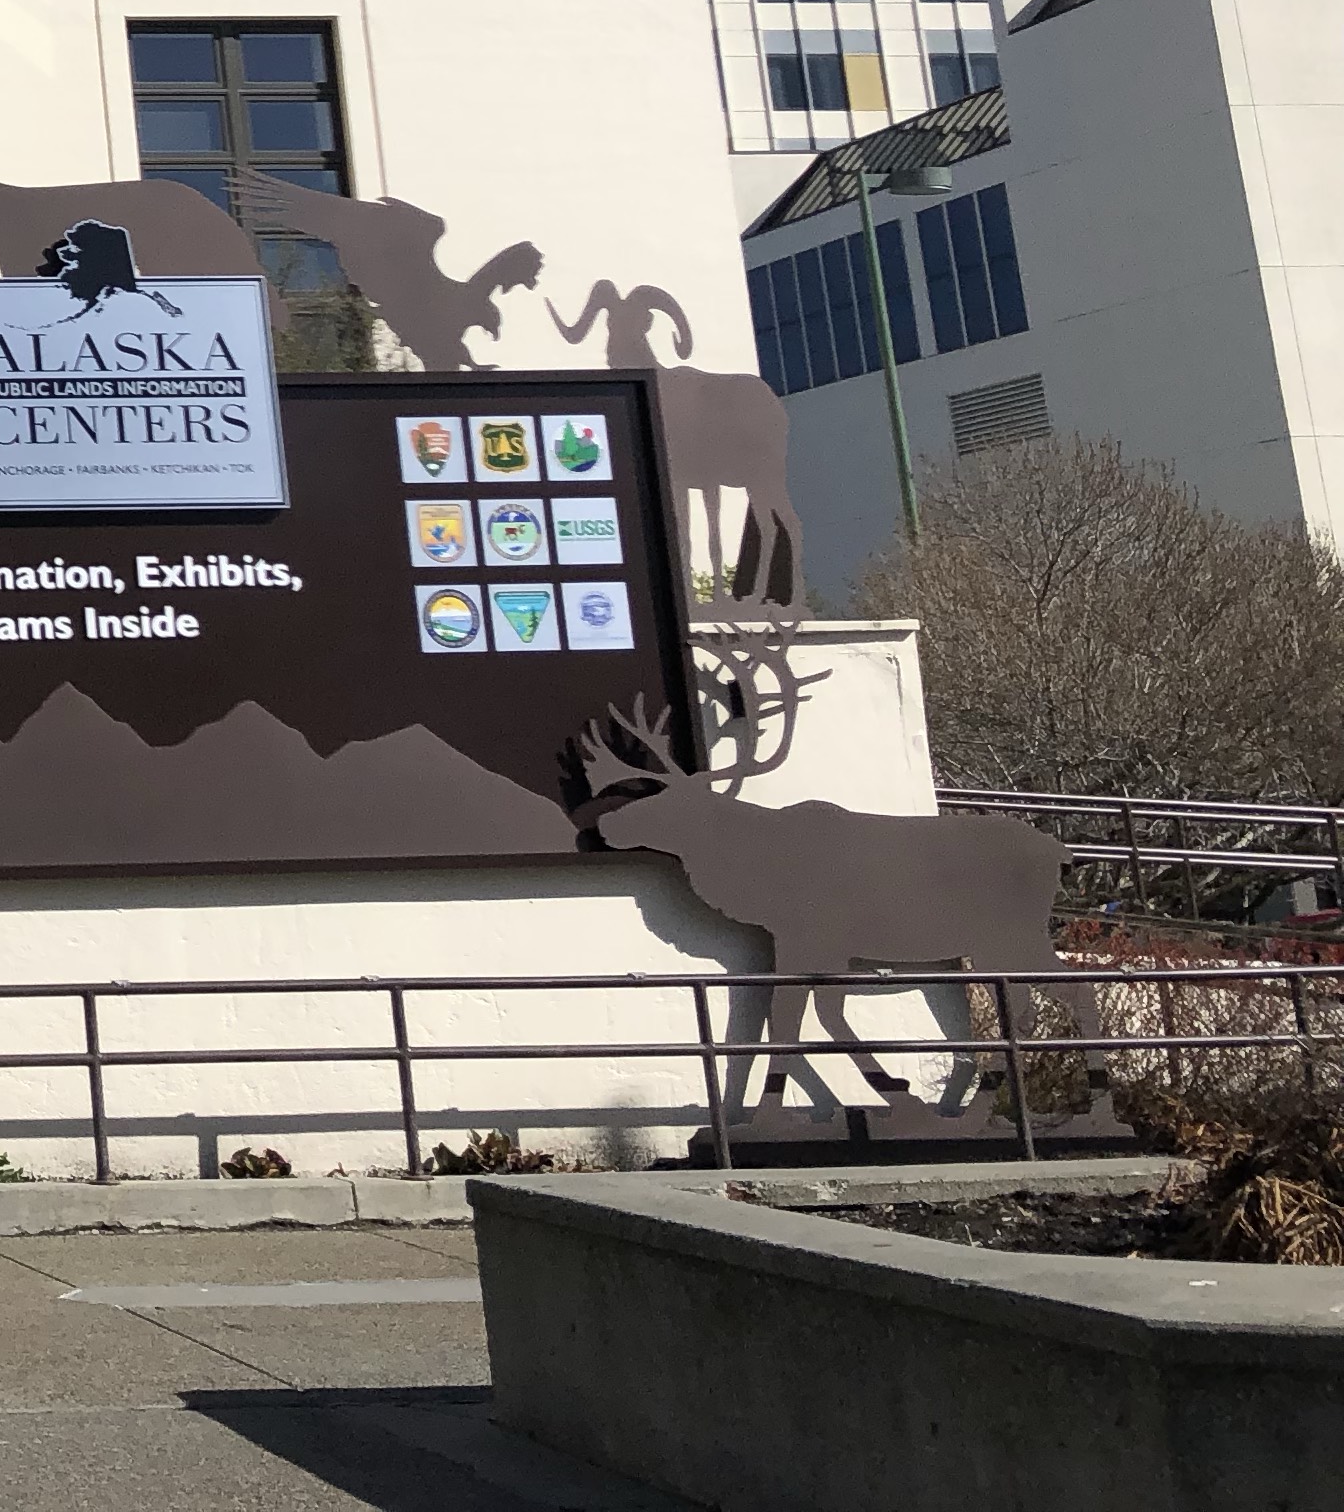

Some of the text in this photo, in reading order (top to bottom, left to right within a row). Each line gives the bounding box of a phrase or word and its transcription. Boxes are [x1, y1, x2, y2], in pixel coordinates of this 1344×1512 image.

[53, 381, 114, 397] LANDS
[117, 379, 243, 396] INFORMATION
[76, 464, 140, 475] FAIRBANKS
[150, 464, 220, 475] KETCHIKAN
[574, 519, 616, 536] USGS
[135, 554, 304, 592] Exhibits,
[83, 604, 201, 640] Inside
